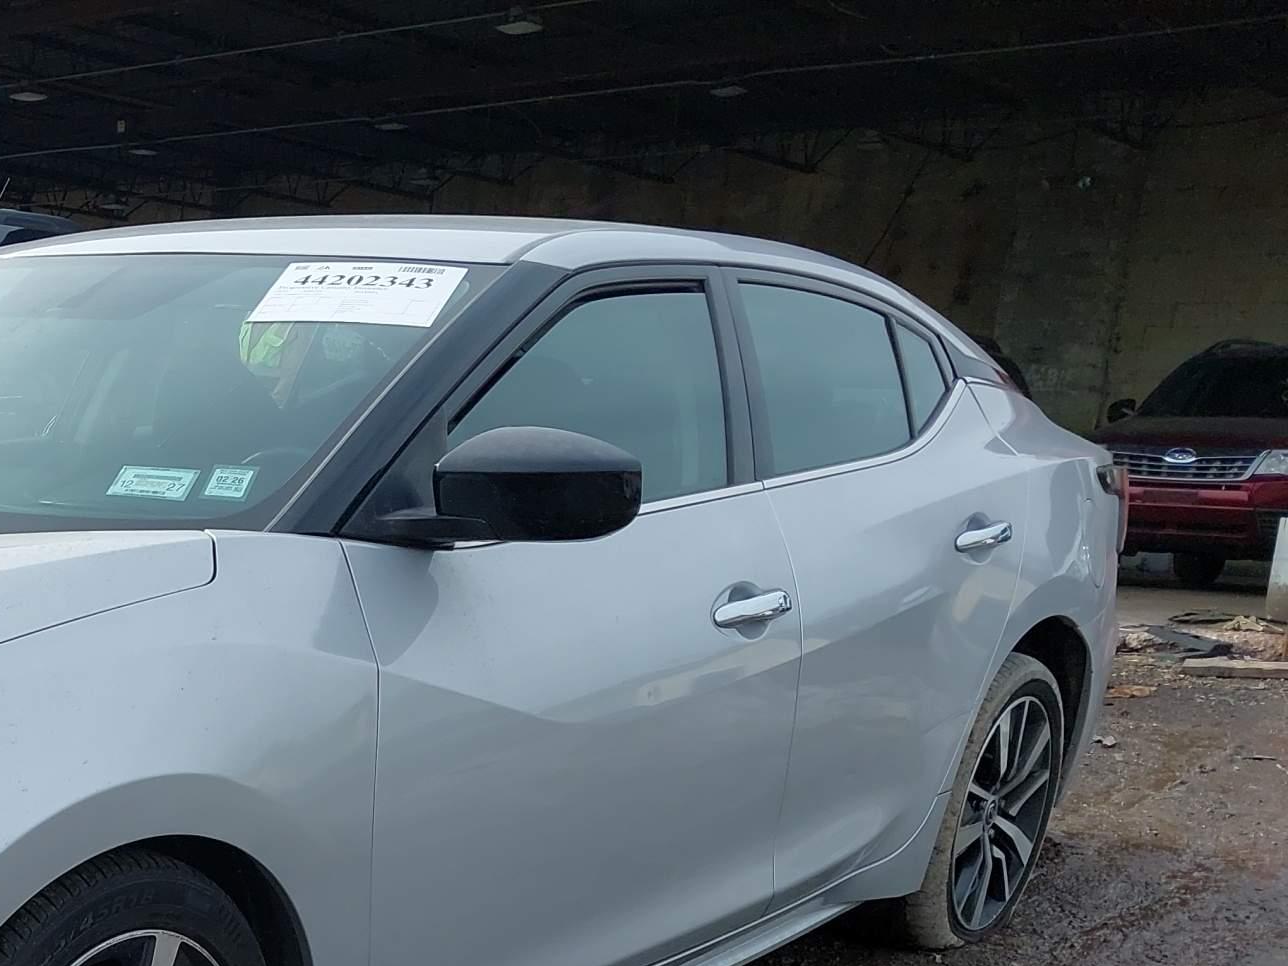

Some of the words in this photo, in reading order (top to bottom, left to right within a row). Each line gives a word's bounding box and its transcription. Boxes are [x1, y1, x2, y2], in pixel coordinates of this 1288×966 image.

[293, 274, 435, 290] 44202343
[119, 479, 134, 489] 12
[166, 482, 186, 493] 27
[216, 475, 229, 483] 02
[231, 476, 245, 485] 26
